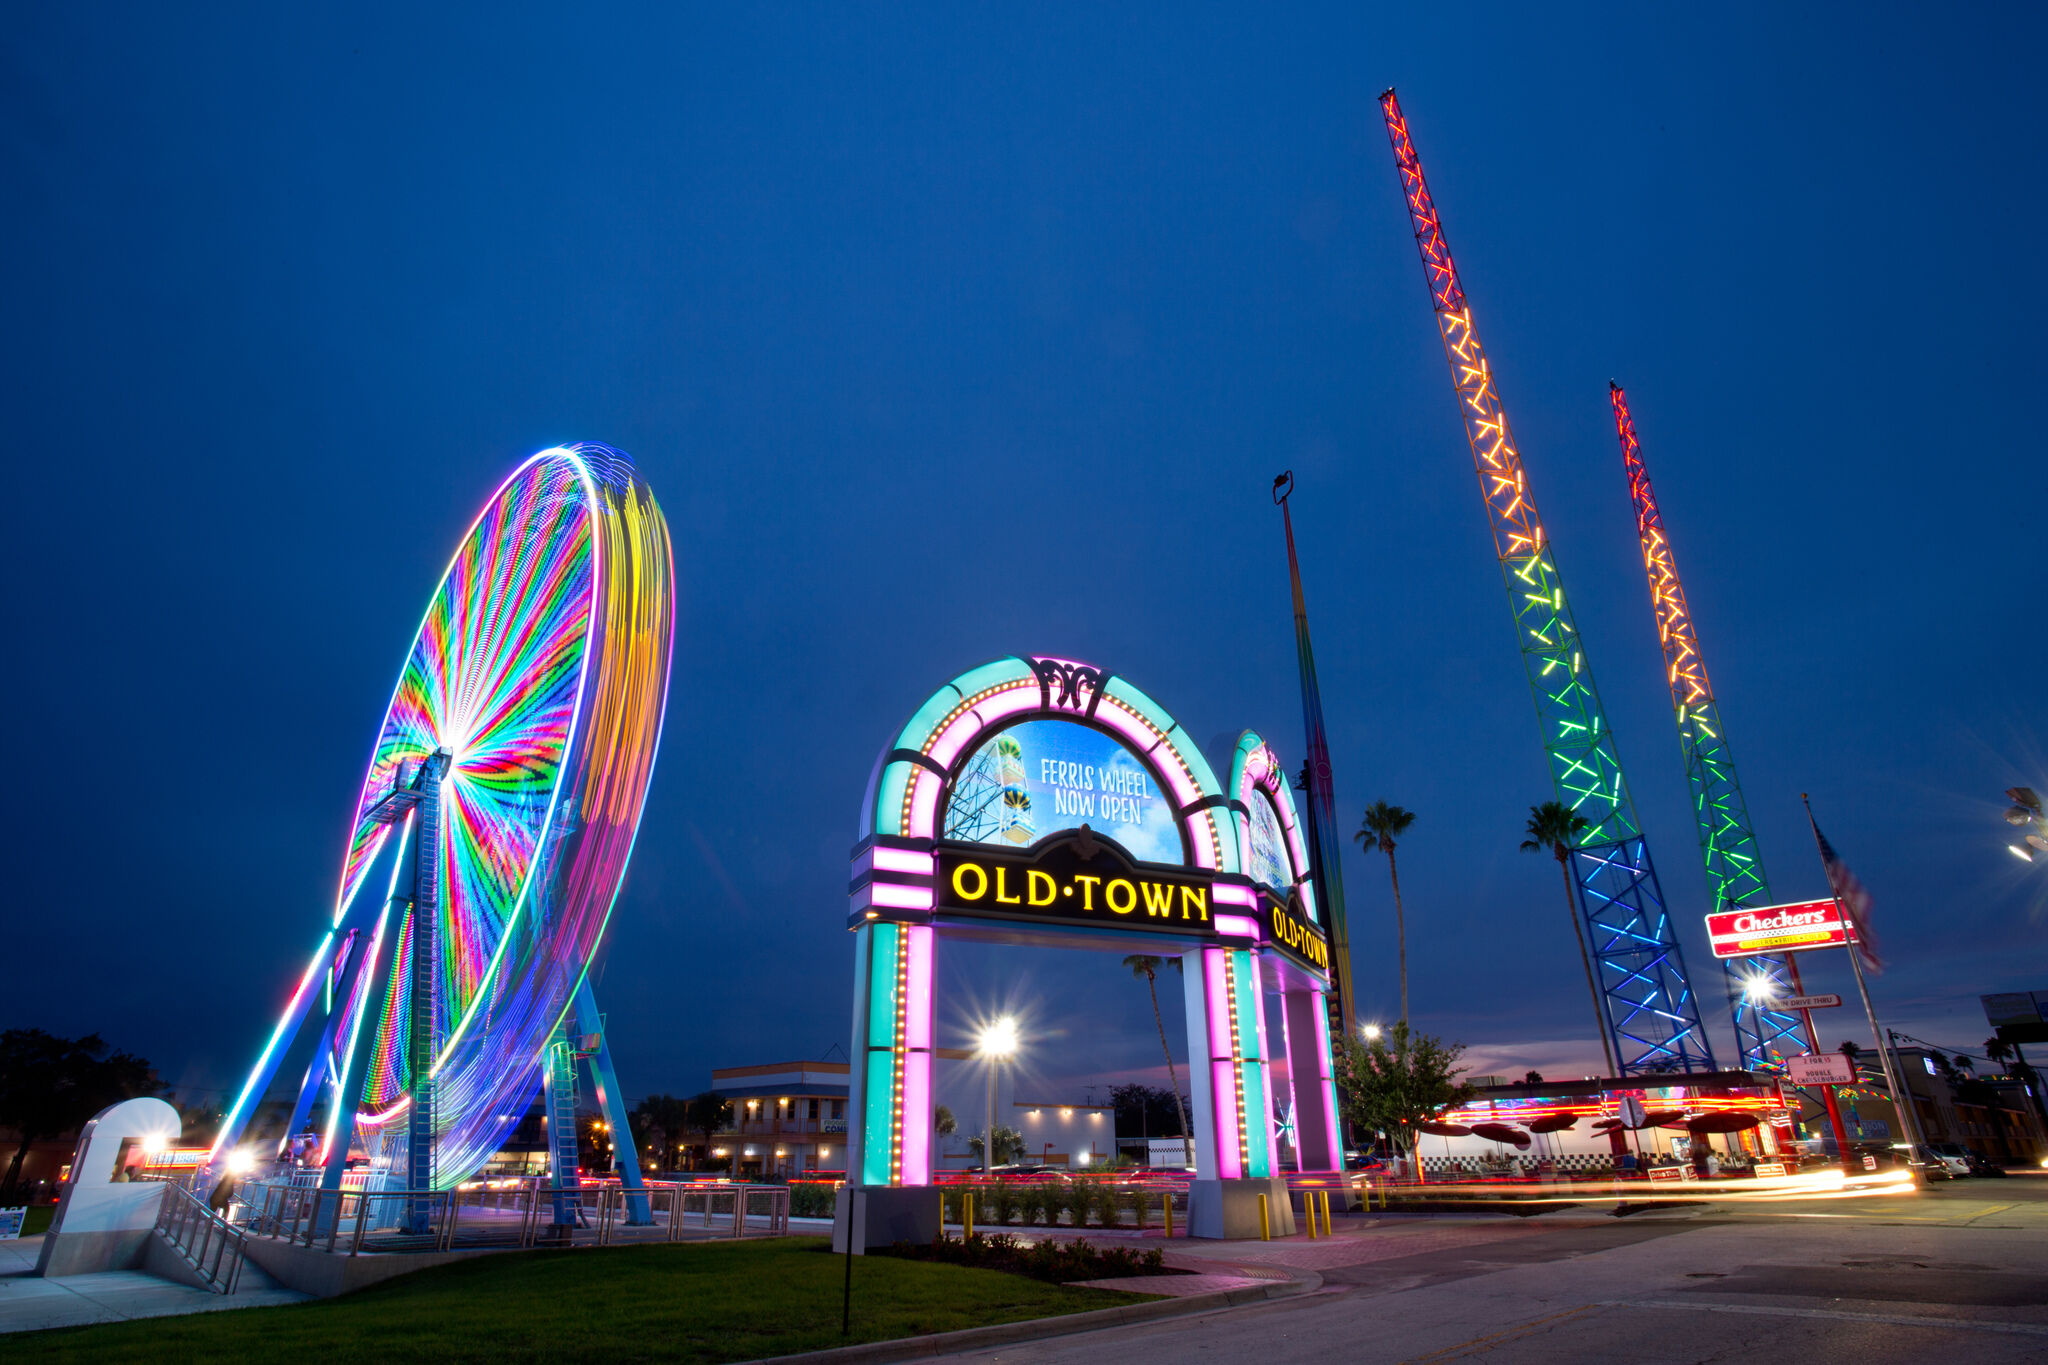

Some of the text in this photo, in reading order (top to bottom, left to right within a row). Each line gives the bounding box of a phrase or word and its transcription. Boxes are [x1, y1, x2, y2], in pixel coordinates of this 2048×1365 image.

[1041, 758, 1152, 800] FERRIS WHEEL
[1055, 787, 1142, 825] NOW OPEN
[1733, 909, 1825, 932] Checkers
[1790, 998, 1811, 1007] DRIVE
[1813, 996, 1833, 1005] THRU
